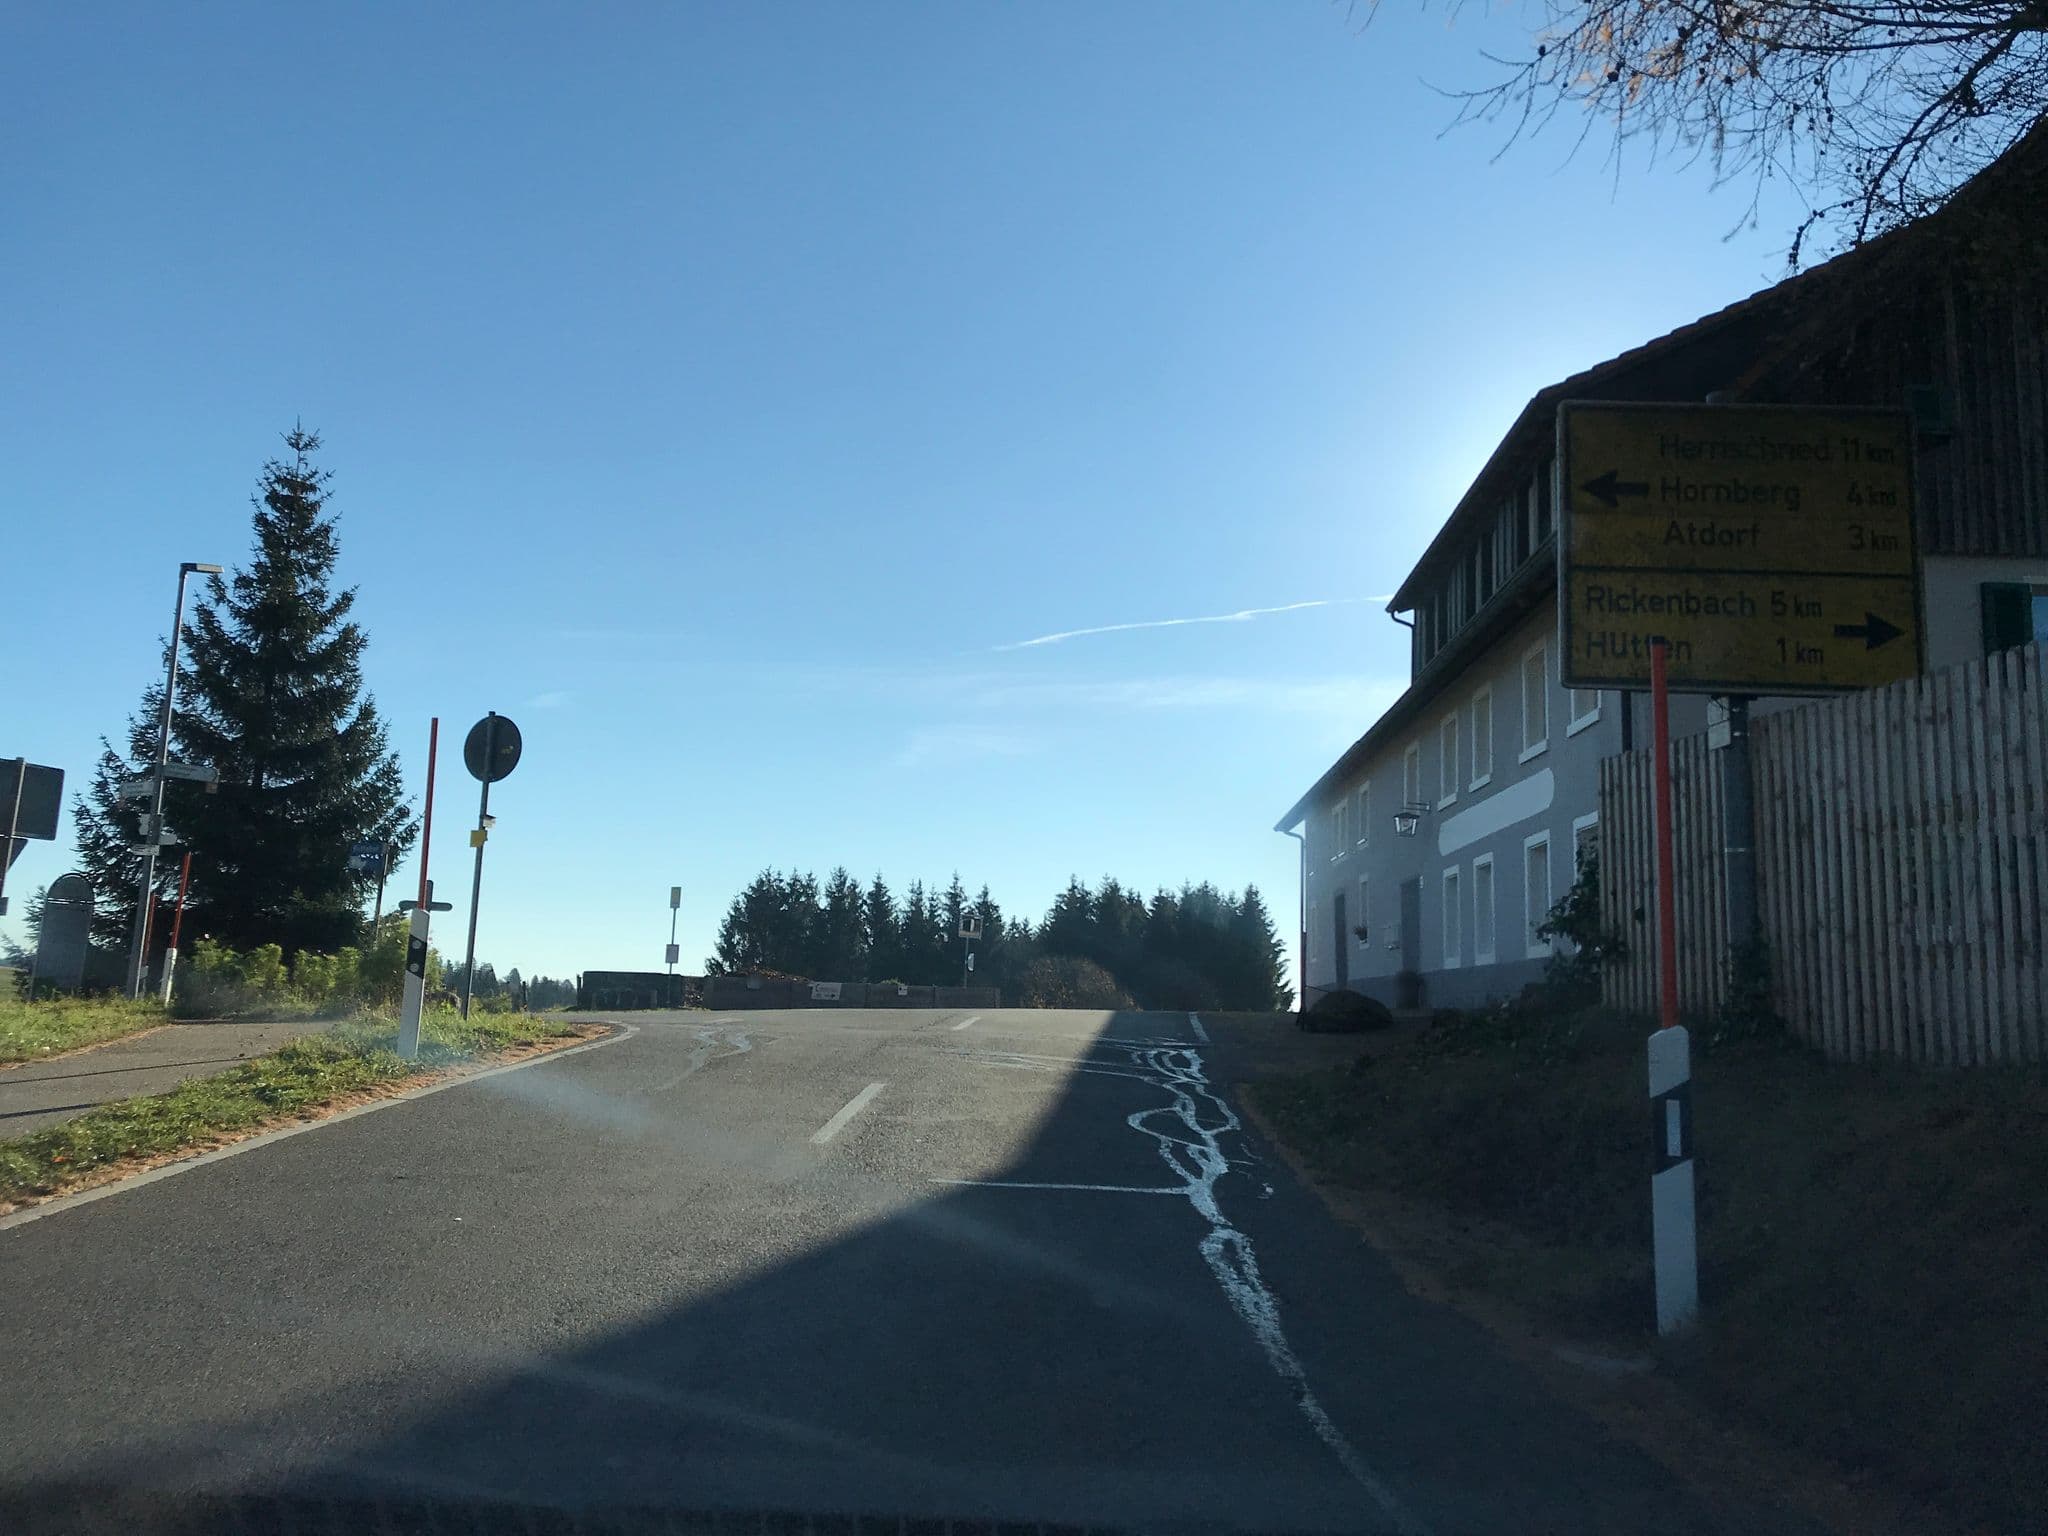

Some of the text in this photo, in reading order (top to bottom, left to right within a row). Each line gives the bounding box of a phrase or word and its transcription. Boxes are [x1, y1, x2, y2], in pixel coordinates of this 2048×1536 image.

[1840, 436, 1860, 462] 11
[1866, 441, 1895, 463] km
[1661, 476, 1897, 511] Hornberg 4 km
[1662, 520, 1898, 552] Atdorf 3 km
[1585, 585, 1823, 618] Rickenbach 5 km
[1775, 638, 1787, 665] 1
[1796, 640, 1824, 666] km
